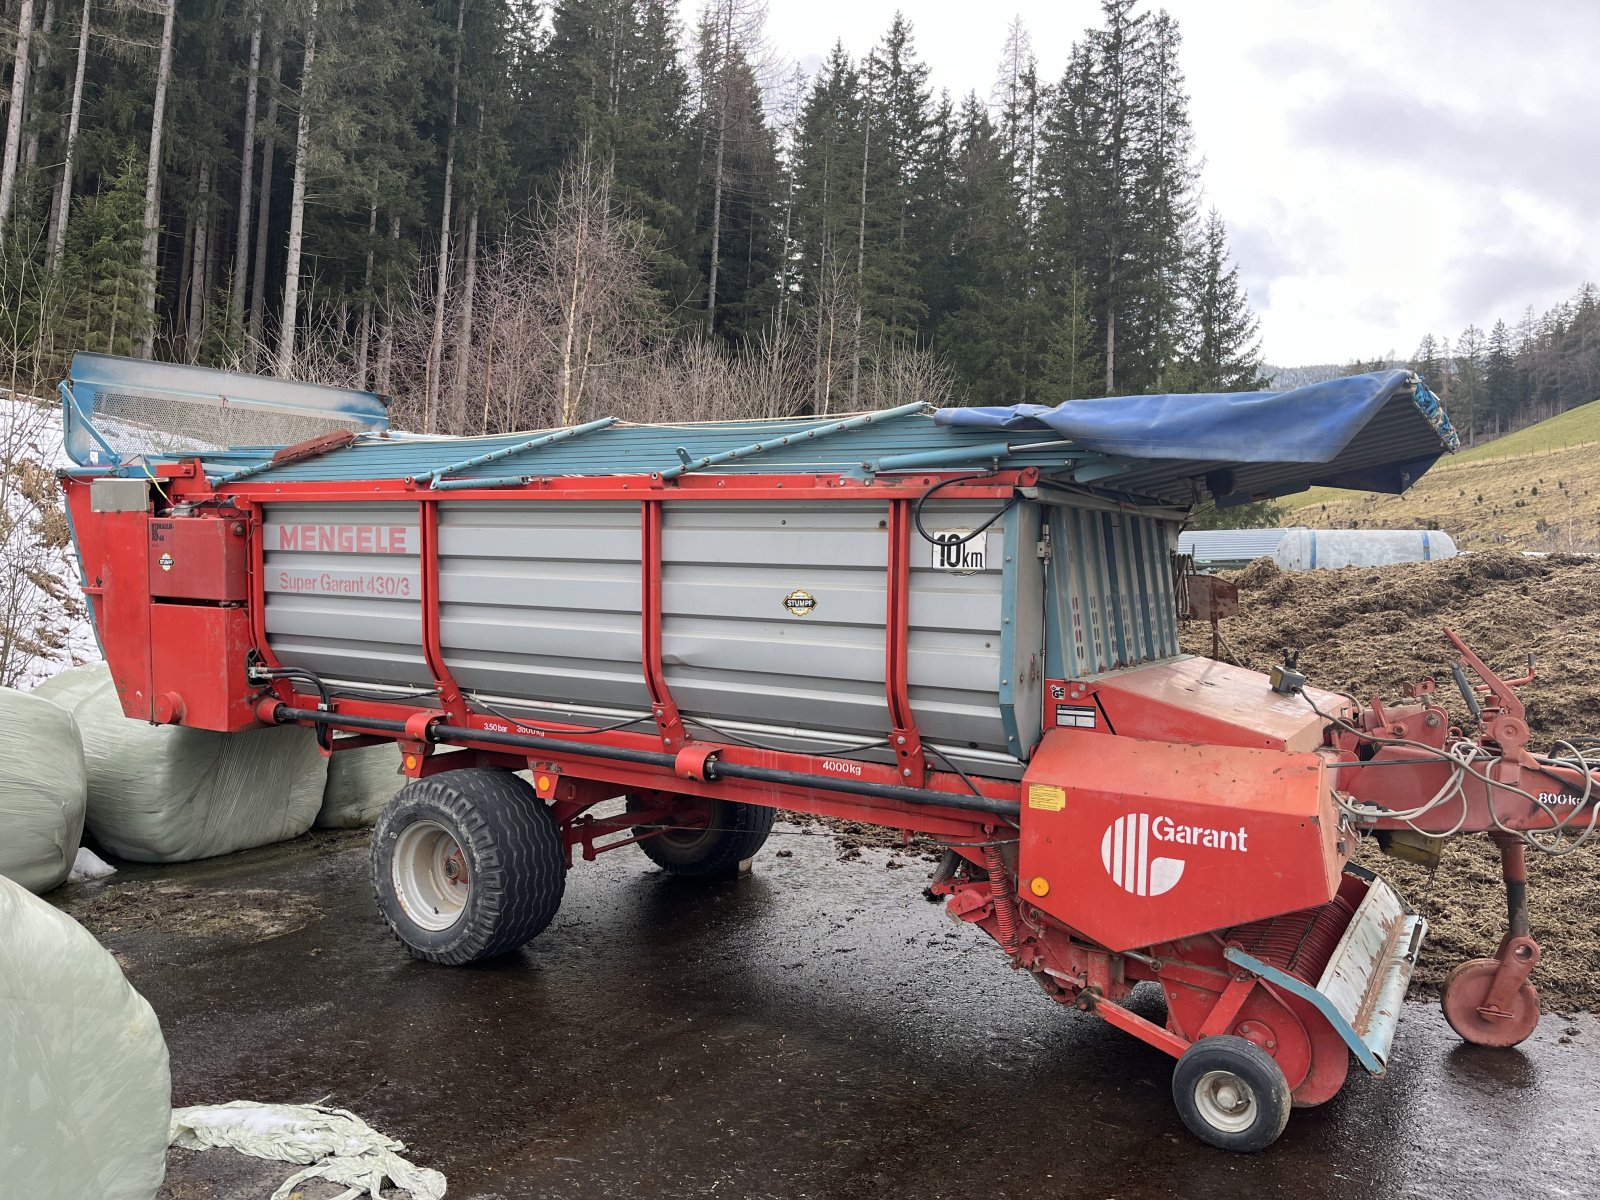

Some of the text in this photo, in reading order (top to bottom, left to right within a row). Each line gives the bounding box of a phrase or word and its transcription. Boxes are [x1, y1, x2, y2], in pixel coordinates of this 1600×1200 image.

[280, 525, 406, 554] MENGELE
[280, 572, 410, 596] Super Garant 430/3
[787, 599, 813, 607] STUMPF
[1151, 815, 1248, 852] Garant
